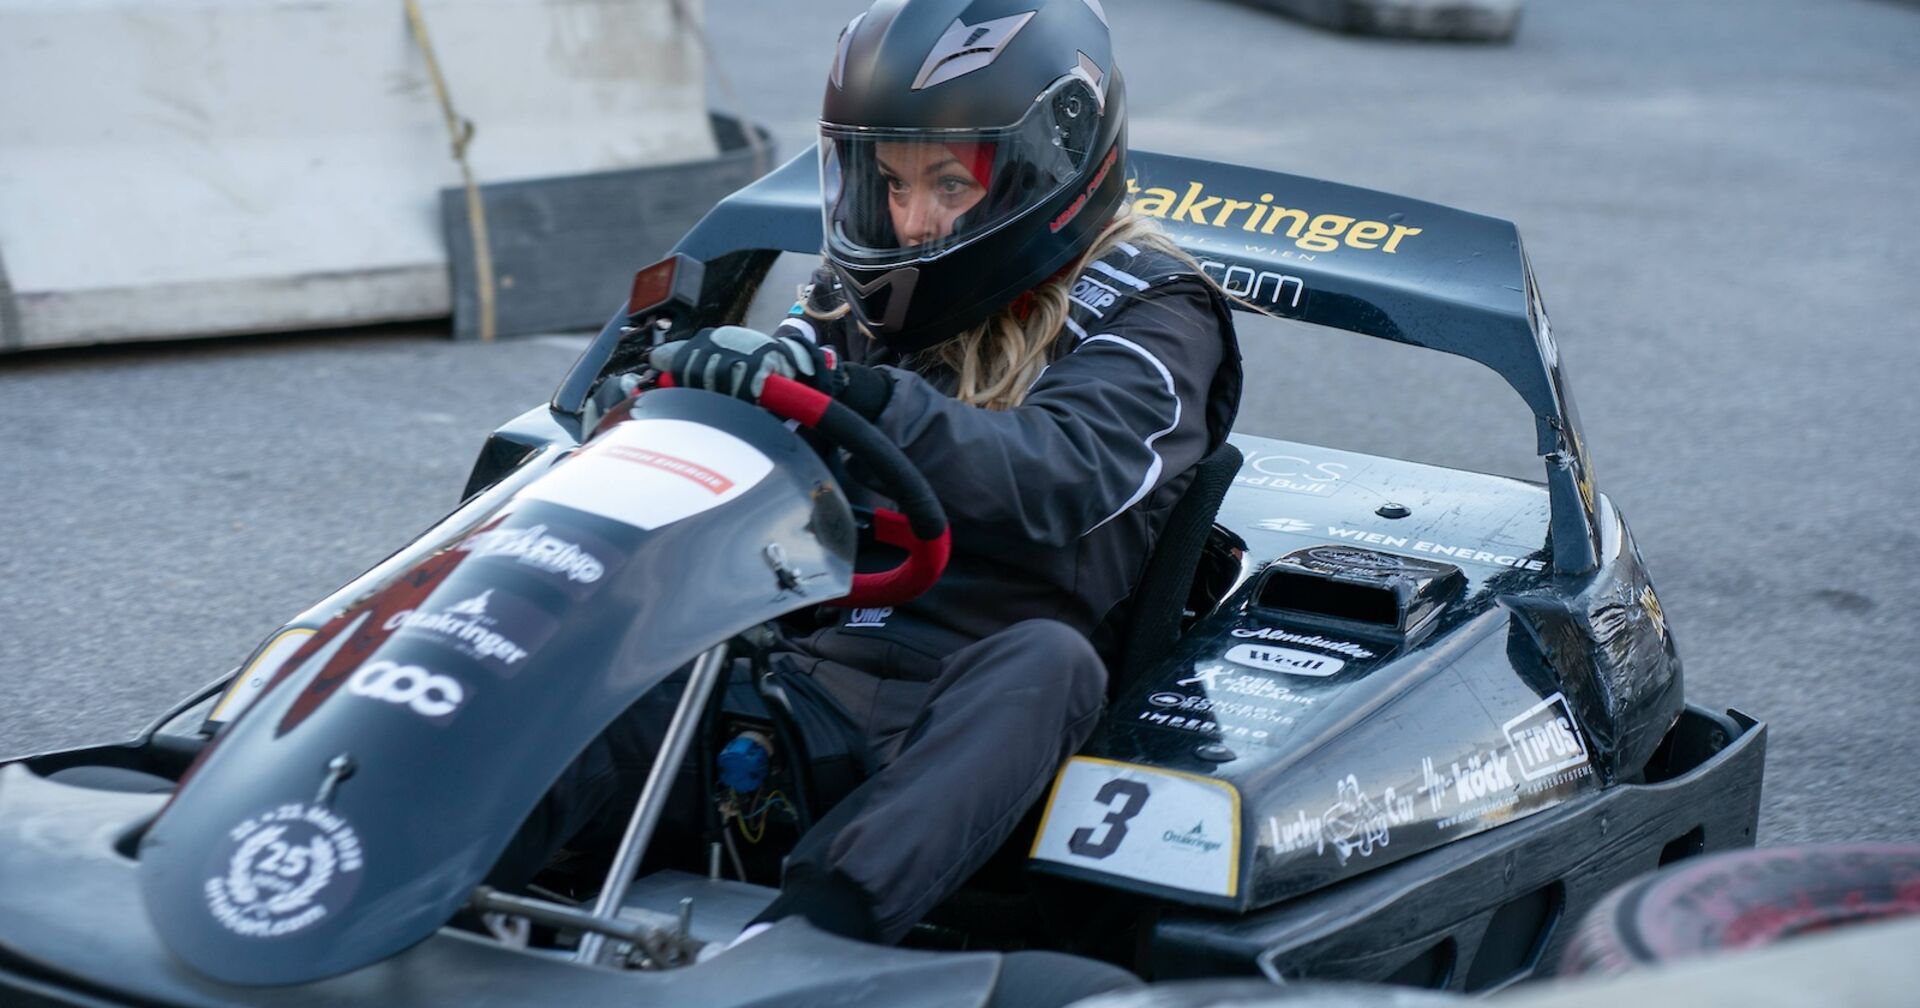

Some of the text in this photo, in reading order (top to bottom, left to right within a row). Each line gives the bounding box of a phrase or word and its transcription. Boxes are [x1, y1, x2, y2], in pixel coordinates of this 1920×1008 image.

[1071, 280, 1116, 307] OMP
[1327, 526, 1409, 549] WIEN
[1411, 541, 1548, 571] ENERGIE
[1067, 778, 1152, 860] 3
[1269, 809, 1325, 857] Lucky
[254, 839, 311, 877] 25
